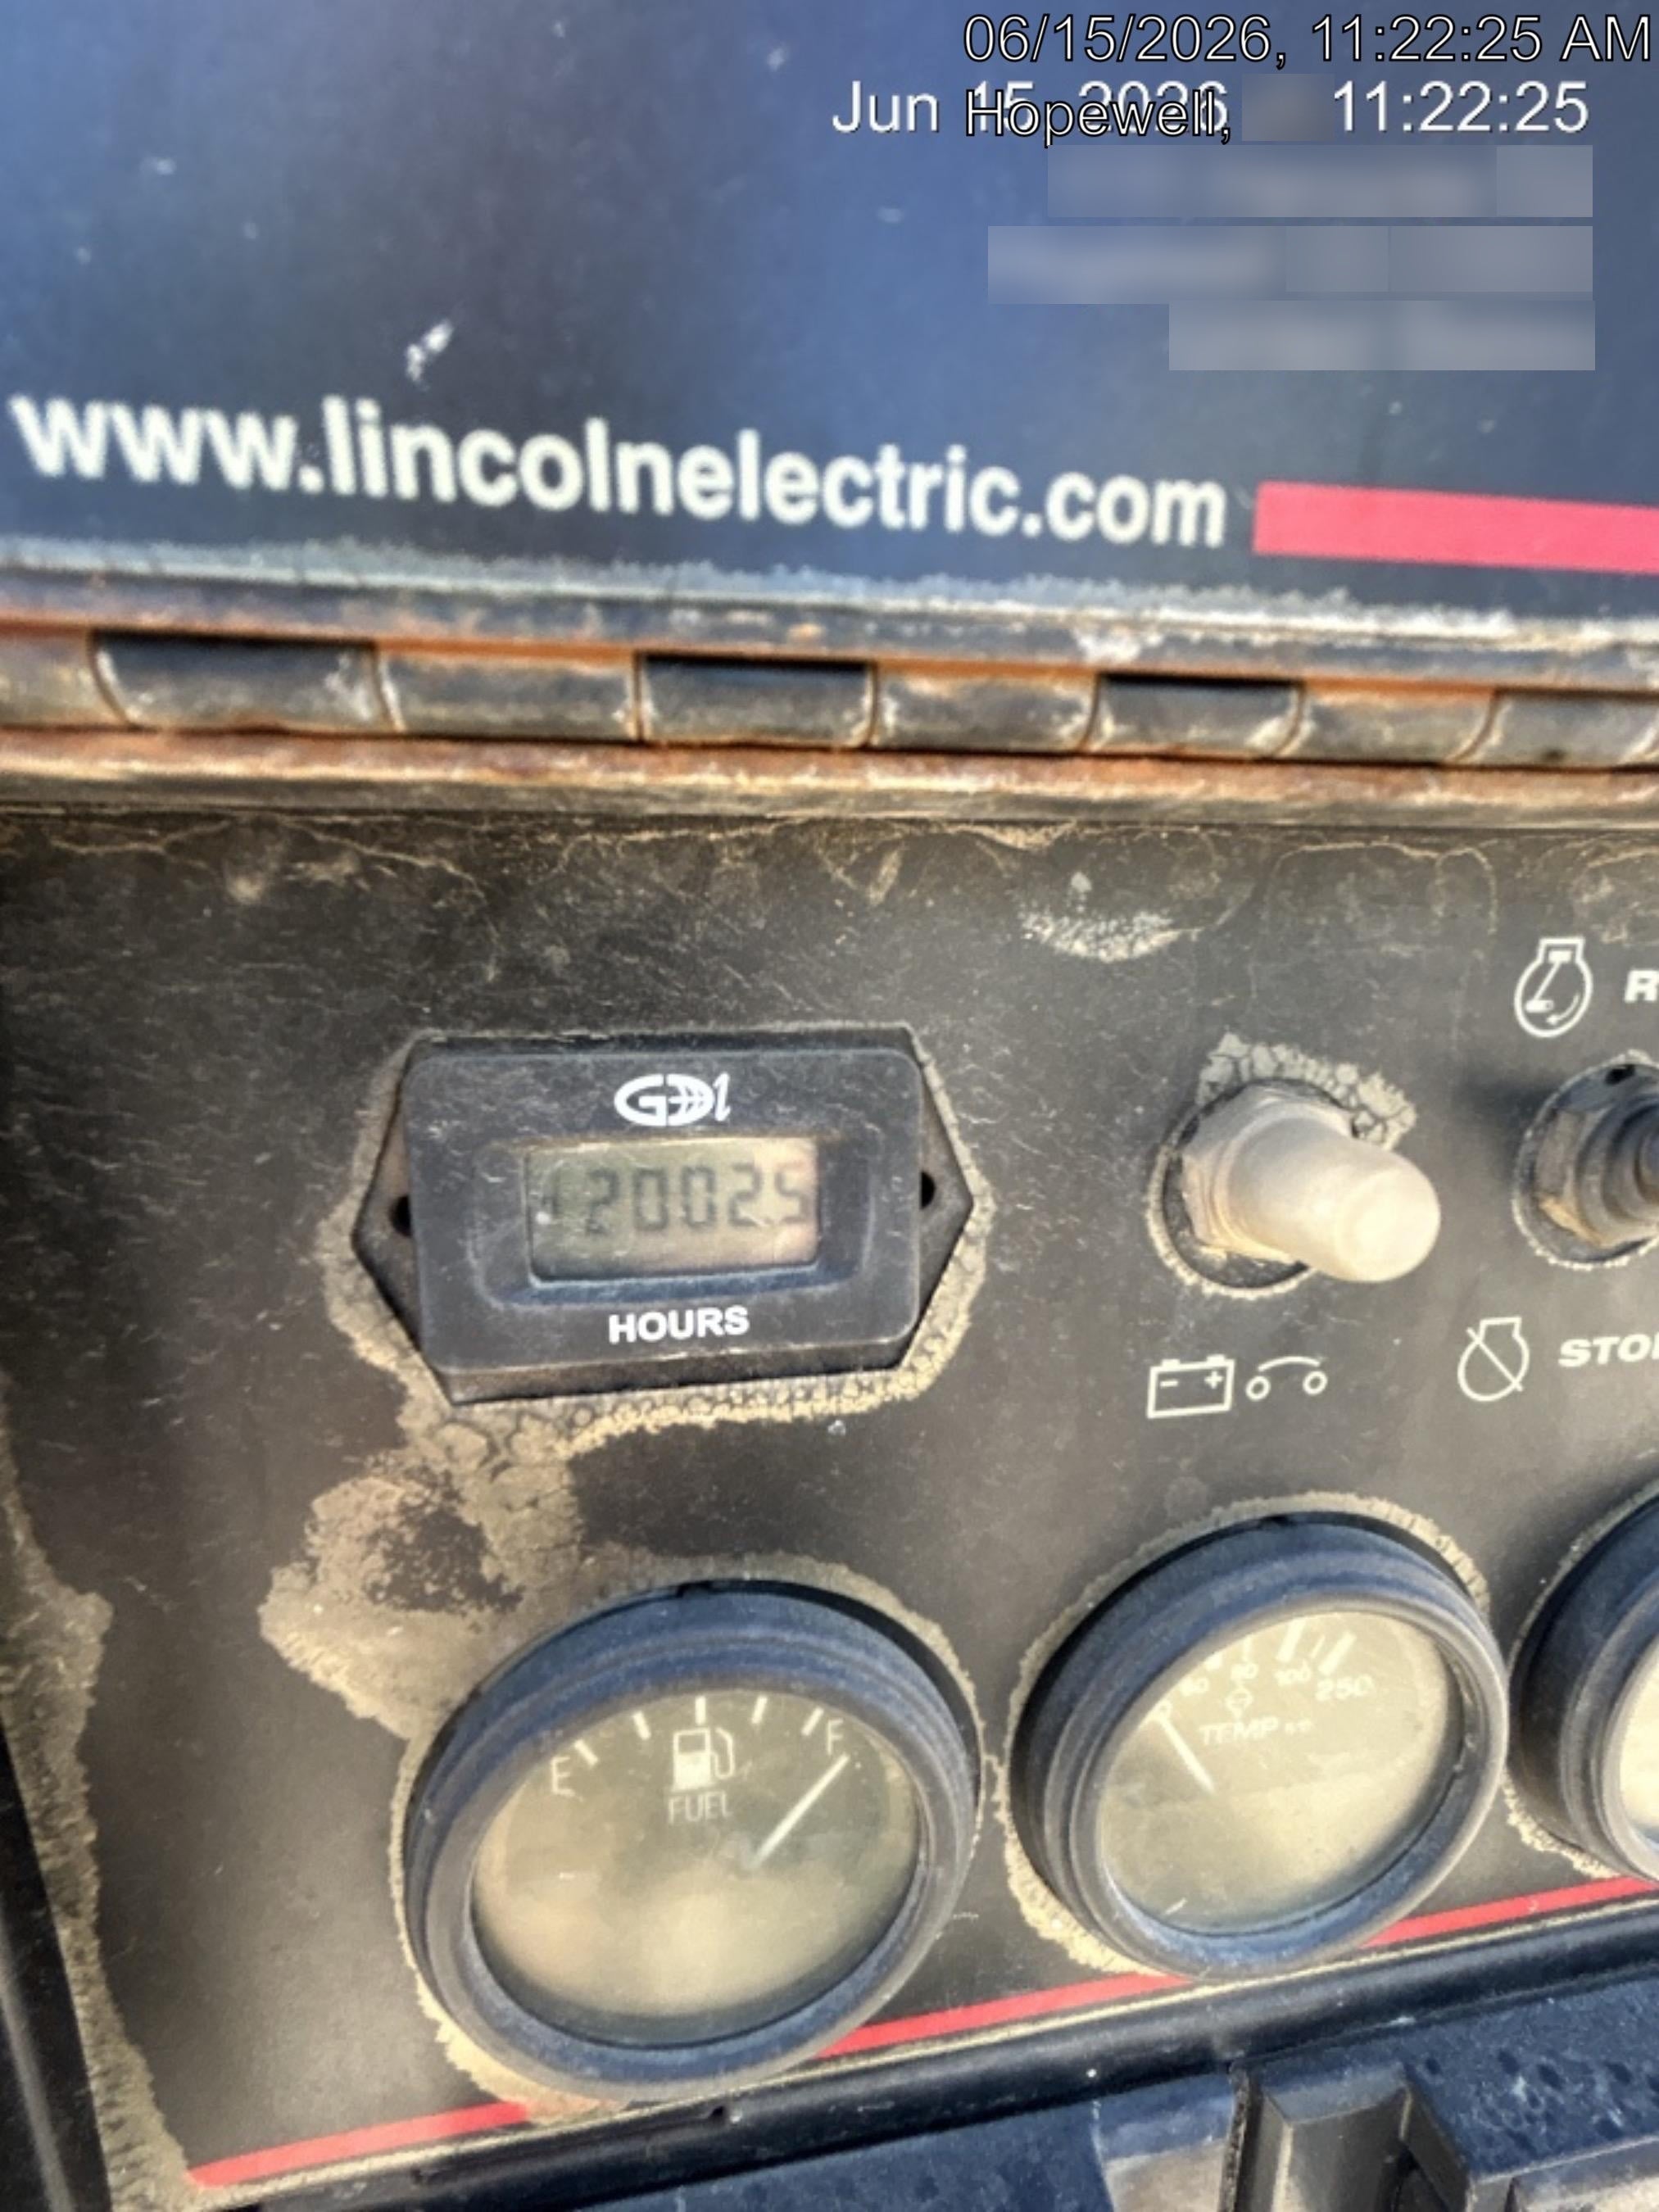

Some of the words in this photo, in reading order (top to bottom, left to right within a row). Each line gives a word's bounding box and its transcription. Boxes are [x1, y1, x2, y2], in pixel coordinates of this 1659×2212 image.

[8, 394, 1226, 548] www.lincolnelectric.com
[609, 1306, 750, 1344] HOURS
[824, 1718, 845, 1756] F
[551, 1756, 576, 1797] E
[667, 1791, 732, 1824] FUEL
